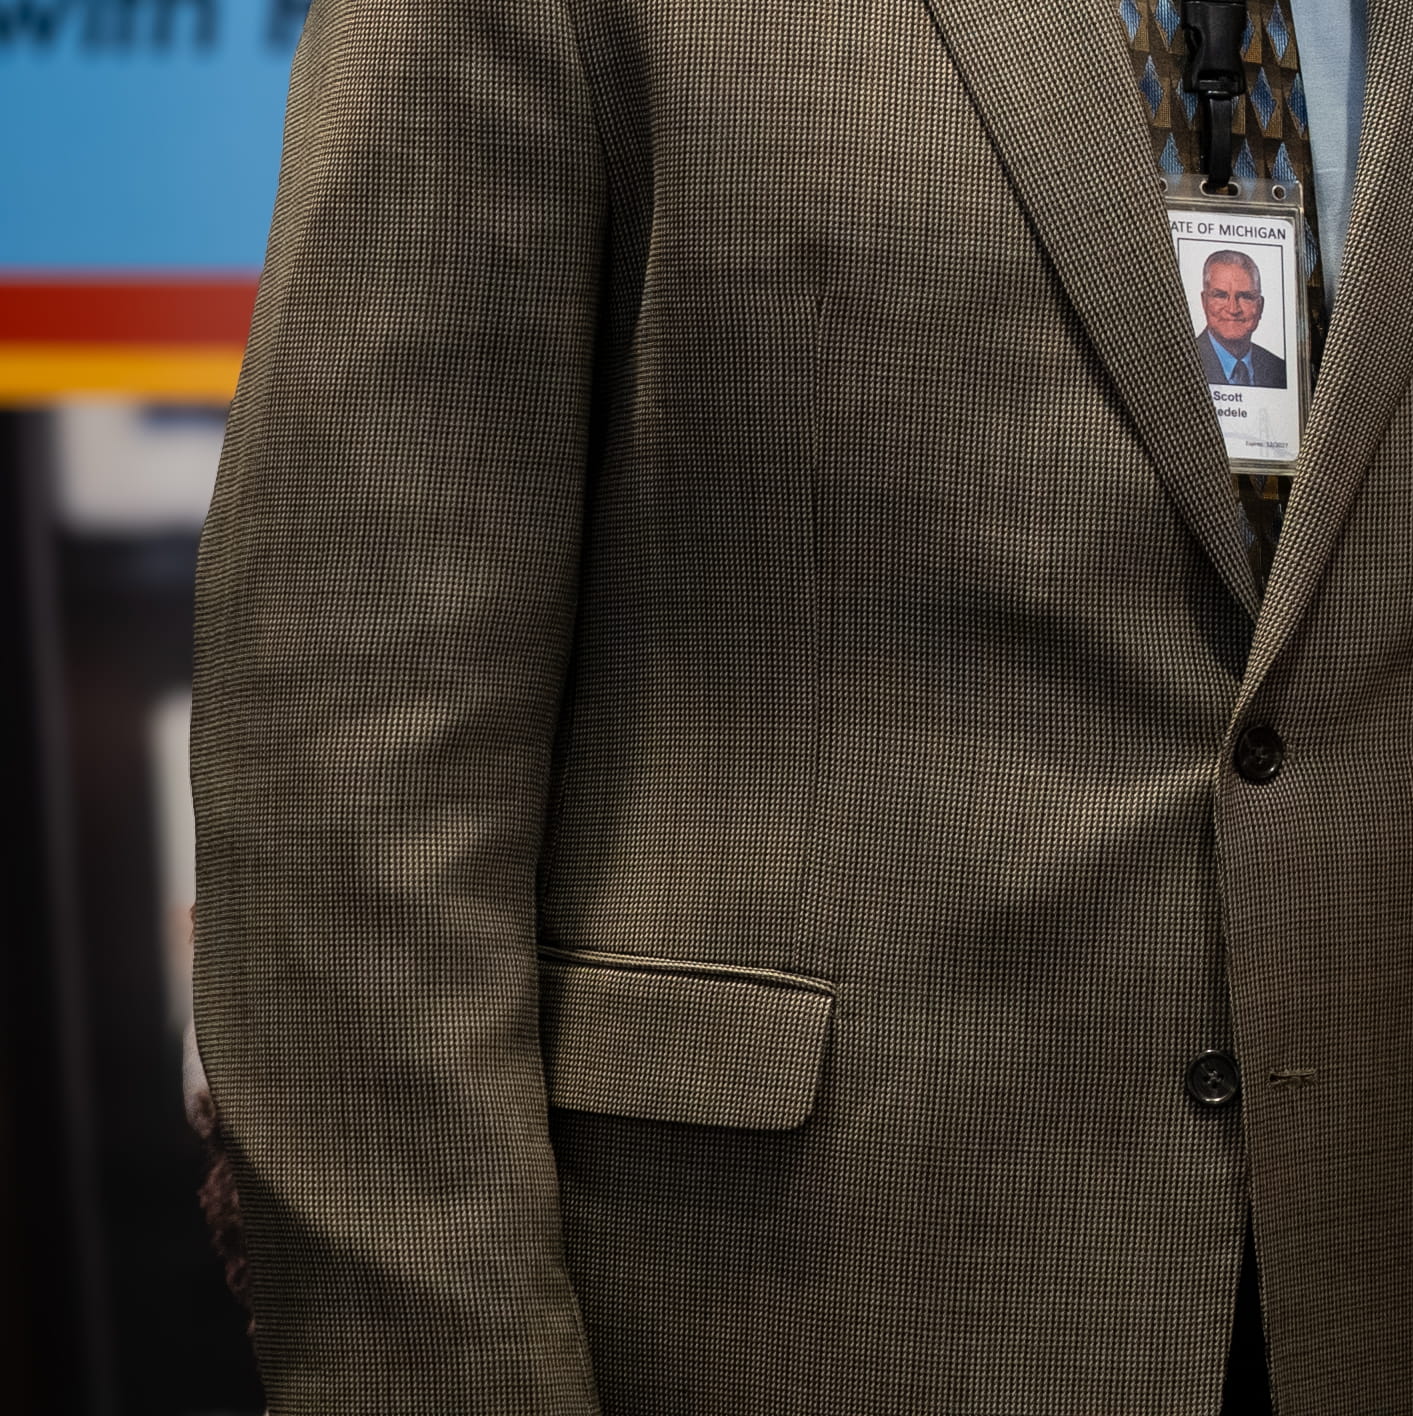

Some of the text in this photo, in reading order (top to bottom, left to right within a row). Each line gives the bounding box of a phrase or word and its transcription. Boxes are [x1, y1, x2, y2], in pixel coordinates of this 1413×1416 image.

[1169, 220, 1287, 240] ATE OF MICHIGAN
[1213, 390, 1243, 402] Scott
[1215, 407, 1248, 418] edele
